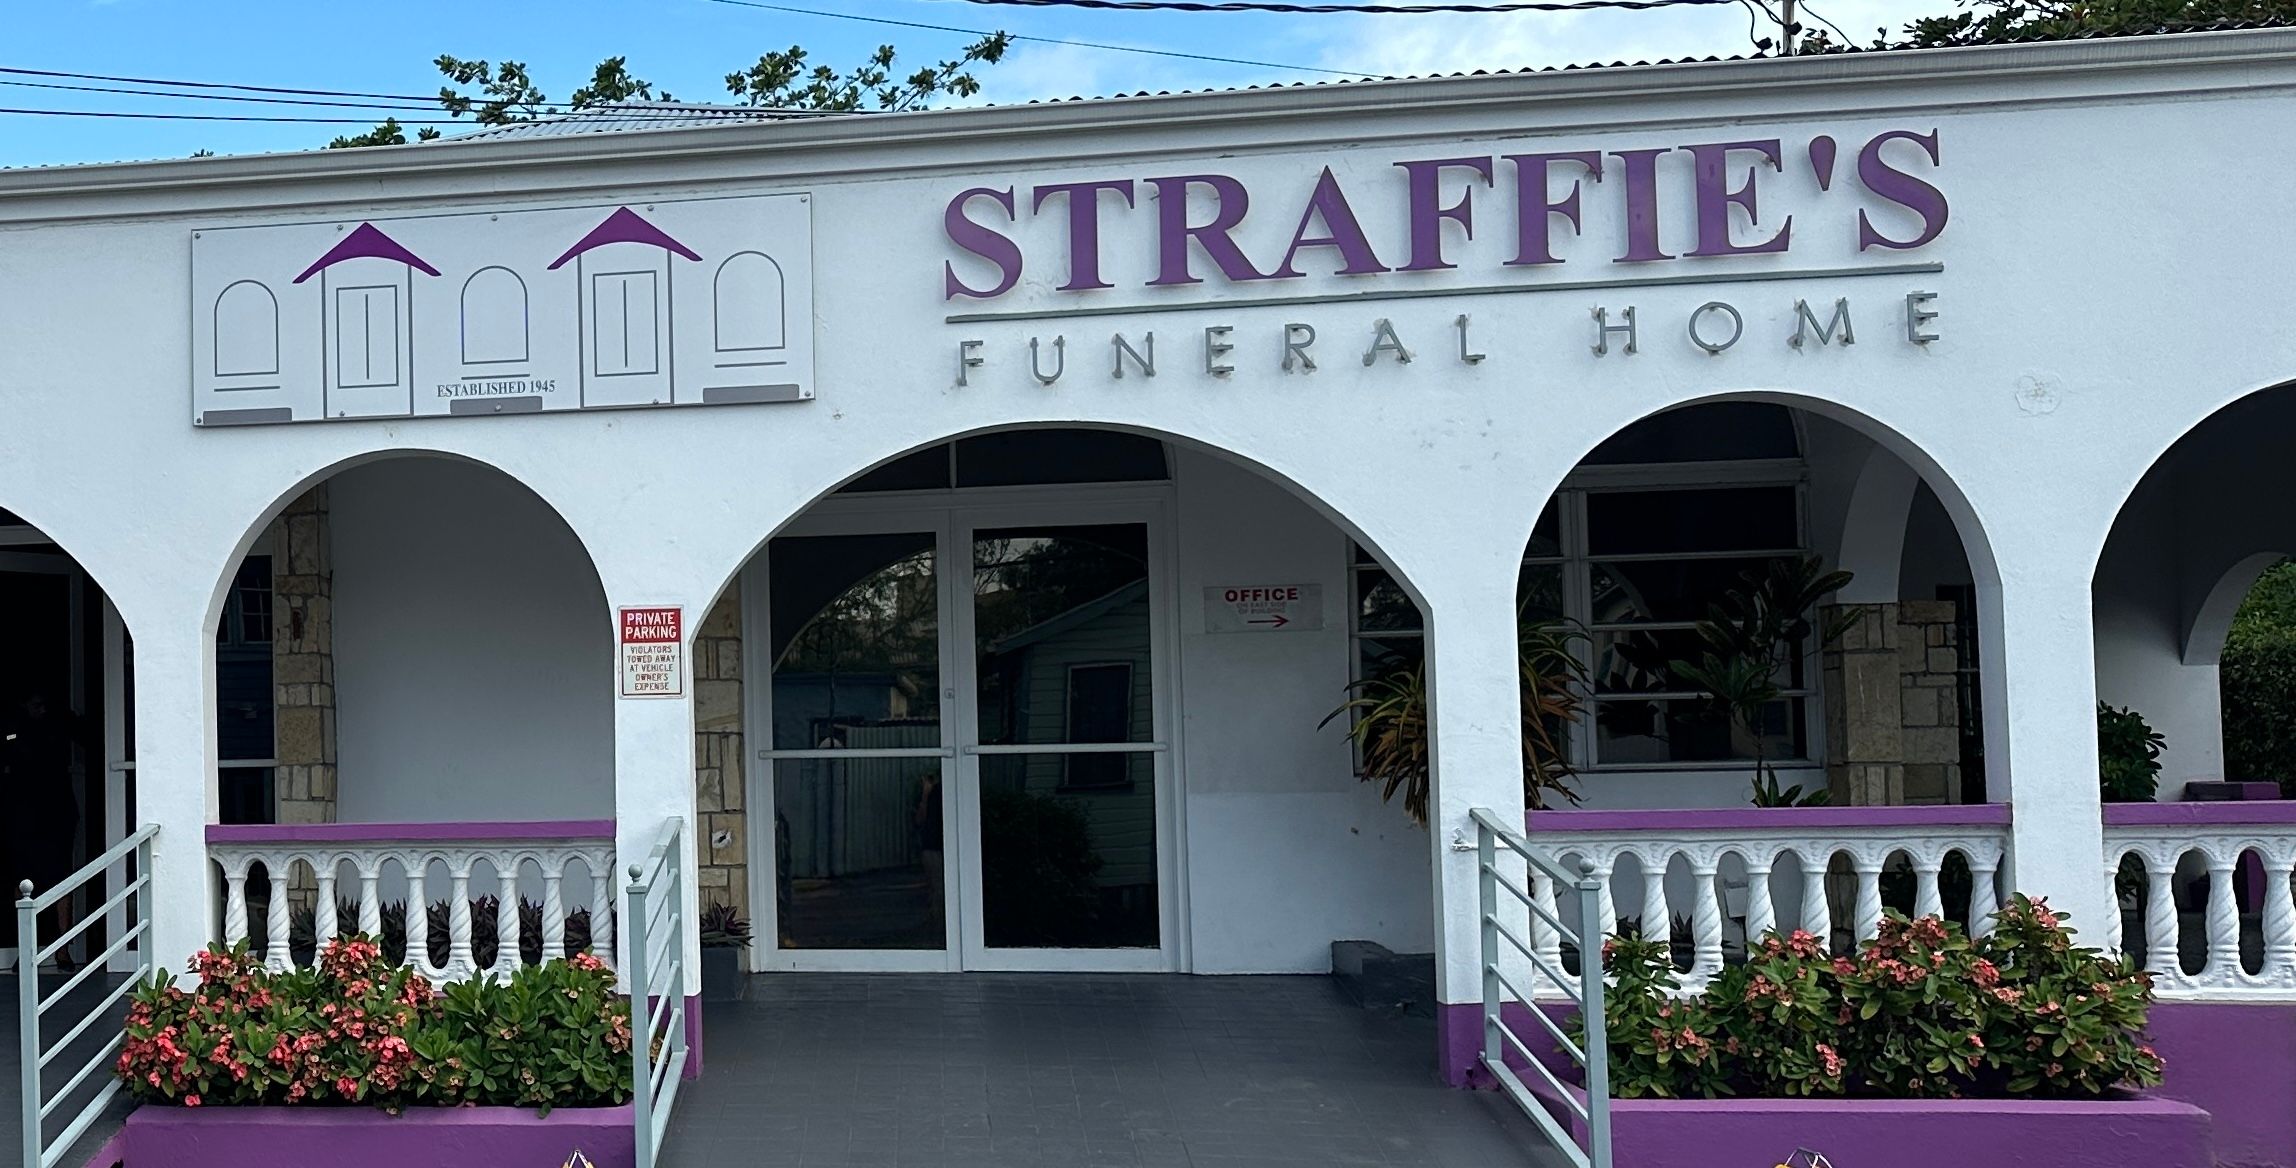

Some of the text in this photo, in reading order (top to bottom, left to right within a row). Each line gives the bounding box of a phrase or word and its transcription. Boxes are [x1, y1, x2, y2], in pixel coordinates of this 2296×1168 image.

[944, 127, 1949, 300] STRAFFIE'S
[957, 291, 1940, 386] FUNERAL HOME
[437, 379, 556, 397] ESTABLISHED 1945
[1224, 588, 1298, 602] OFFICE
[627, 612, 675, 625] PRIVATE
[625, 626, 677, 639] PARKING
[630, 645, 672, 655] VIOLATORS
[627, 655, 676, 664] TOWED AWAY
[629, 664, 673, 672] AT VEHICLE
[635, 673, 669, 681] OWNER'S
[634, 682, 670, 691] EXPENSE
